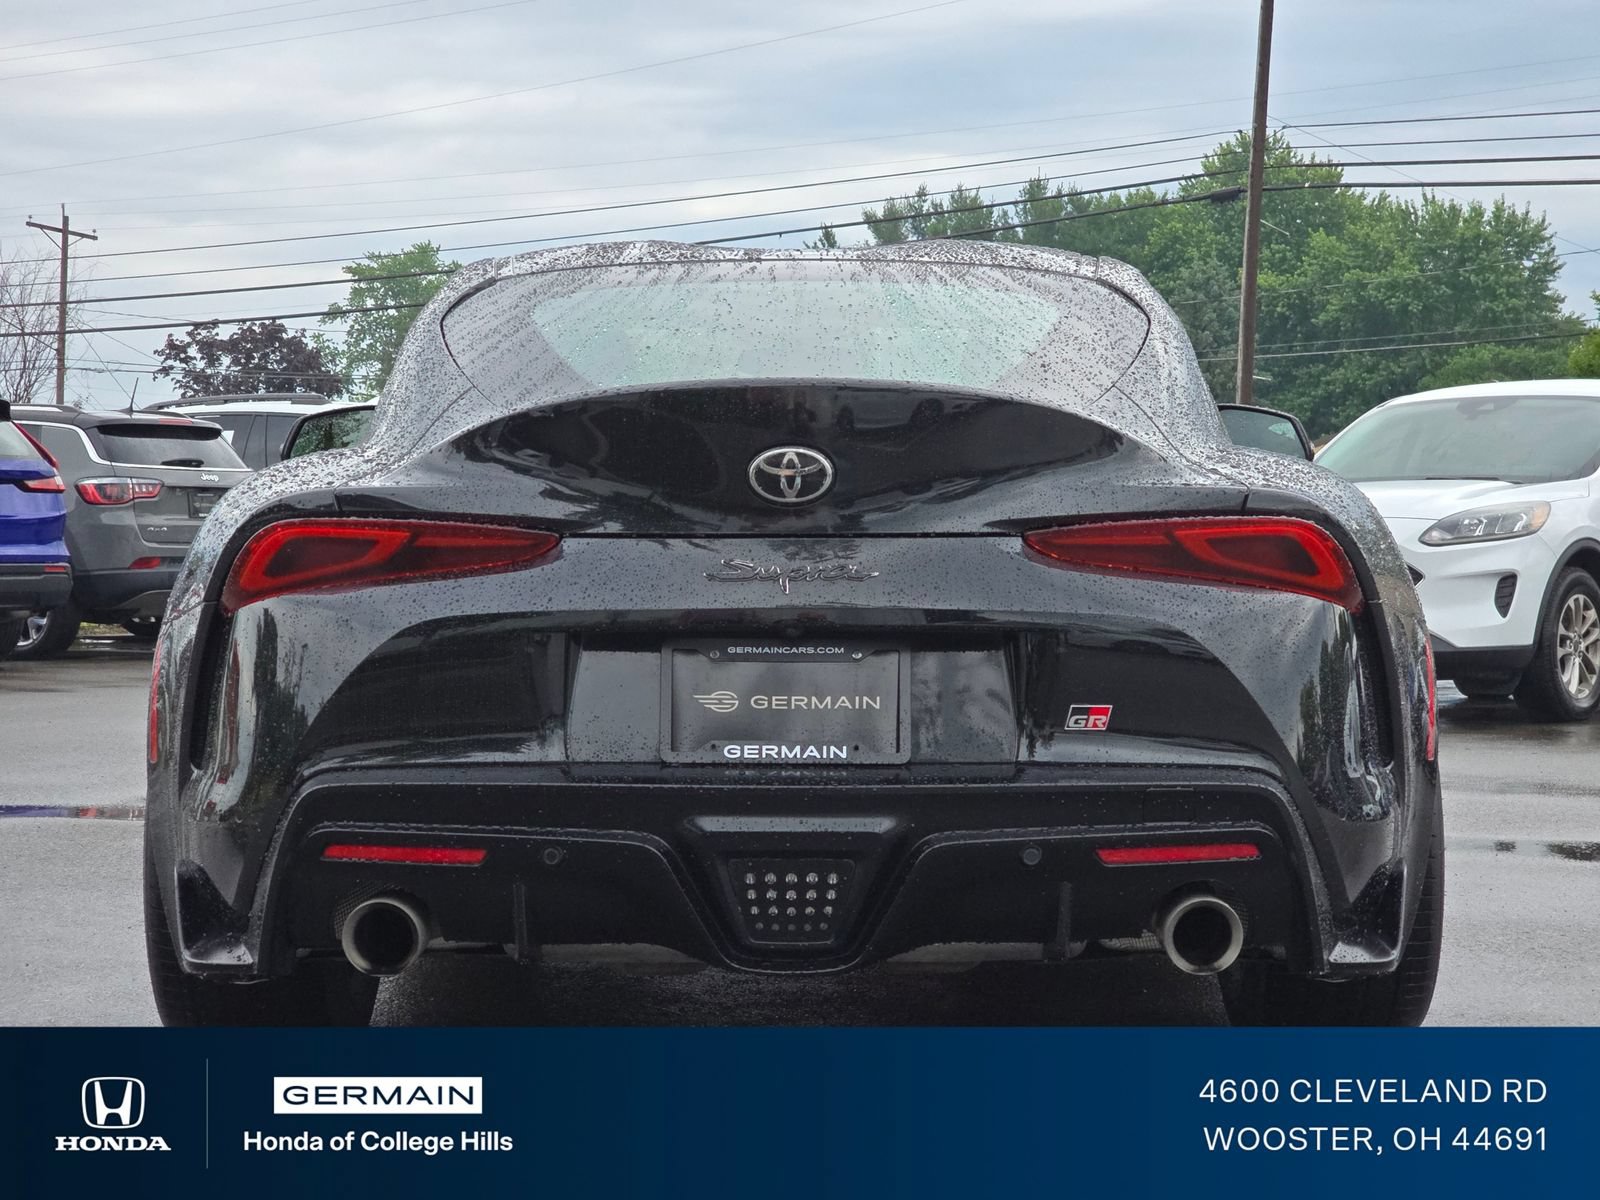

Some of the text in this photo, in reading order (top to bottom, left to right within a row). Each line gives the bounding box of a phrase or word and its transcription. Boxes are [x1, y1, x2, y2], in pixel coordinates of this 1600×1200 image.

[201, 473, 219, 482] Jeep
[703, 559, 880, 595] Supra
[727, 646, 845, 654] GERMAINCARS.COM
[750, 695, 881, 710] GERMAIN
[1068, 715, 1107, 728] GR
[723, 744, 847, 759] GERMAIN
